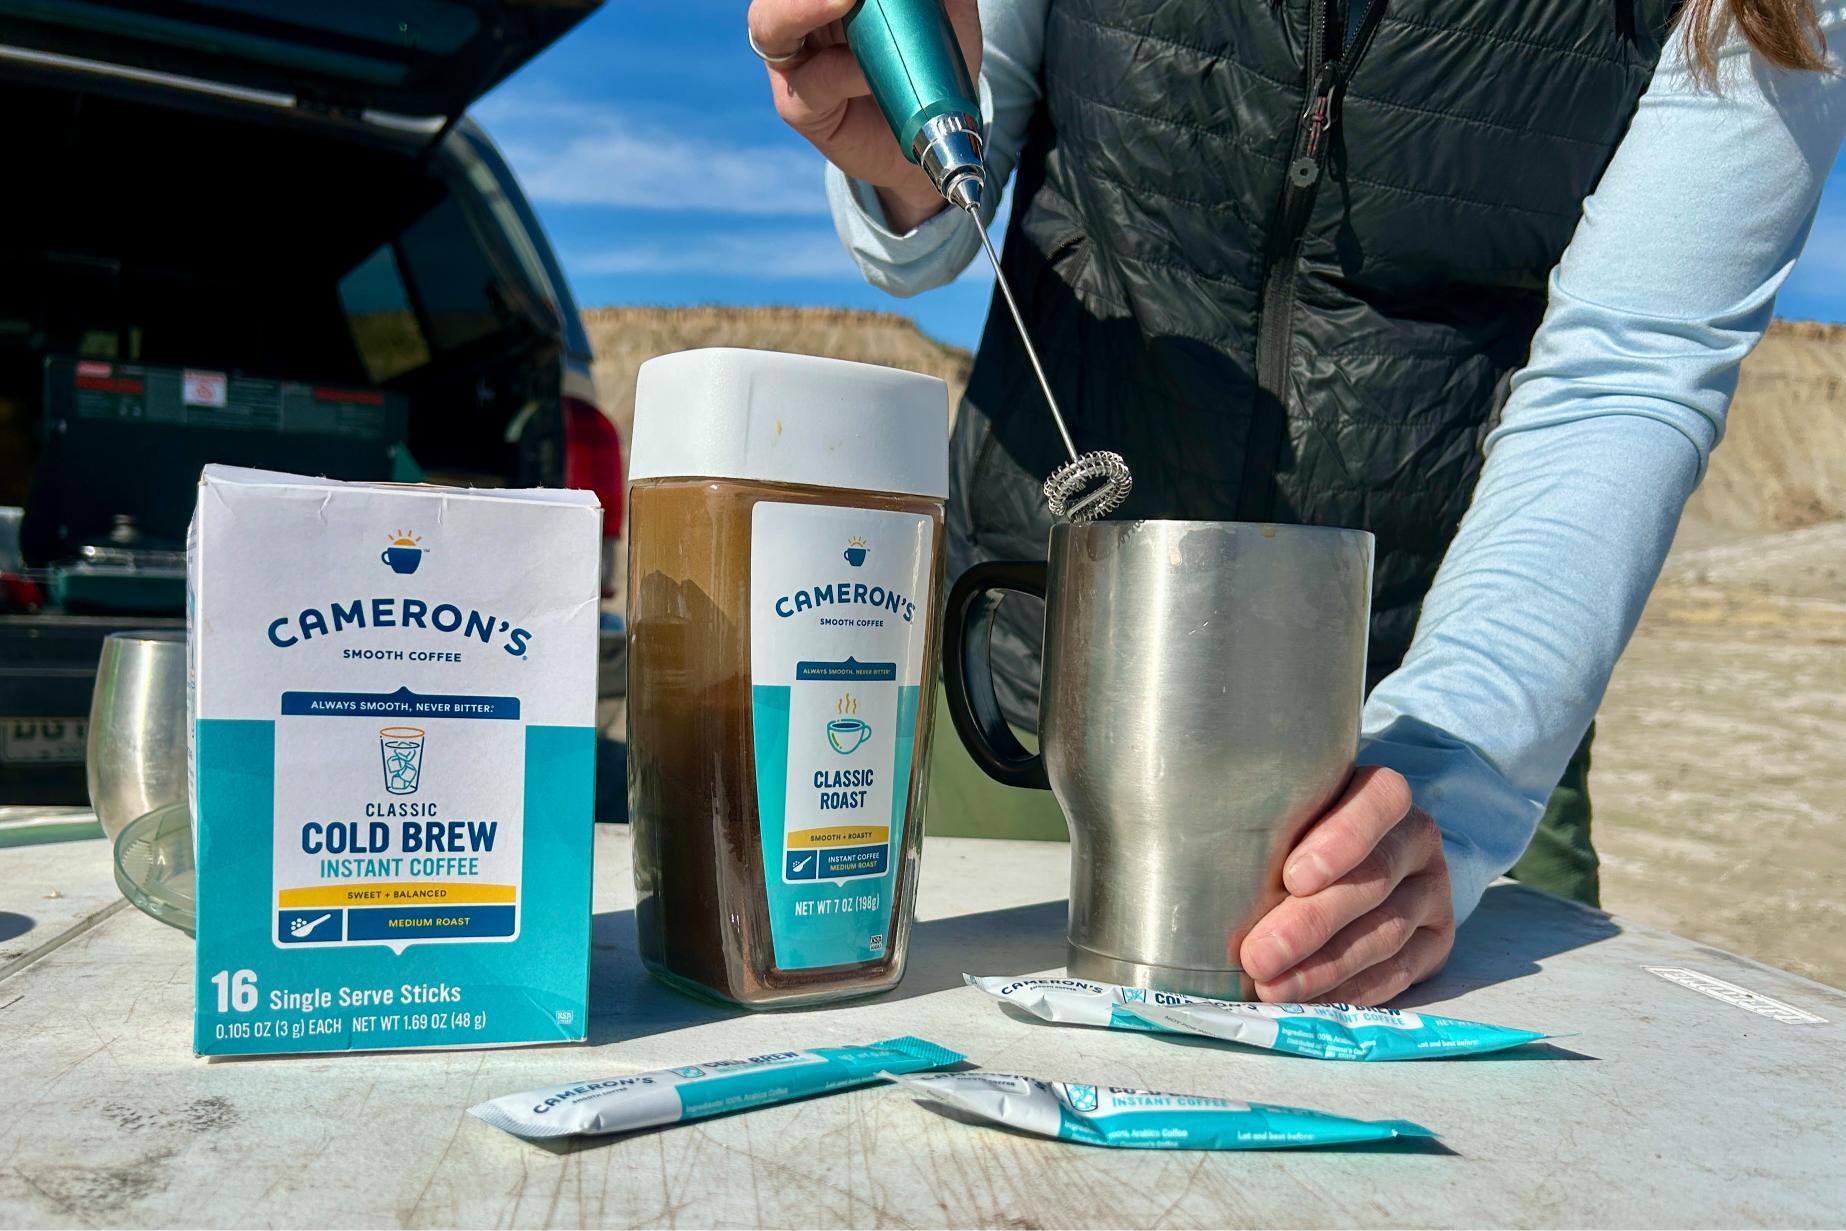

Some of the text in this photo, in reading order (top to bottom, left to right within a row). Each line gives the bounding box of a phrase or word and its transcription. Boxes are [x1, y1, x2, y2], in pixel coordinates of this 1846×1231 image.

[775, 583, 915, 623] CAMERON'S
[267, 598, 533, 657] CAMERON'S
[820, 618, 884, 627] SMOOTH COFFEE
[343, 649, 462, 662] SMOOTH COFFEE
[311, 701, 356, 711] ALWAYS
[360, 702, 412, 712] SMOOTH,
[416, 702, 451, 712] NEVER
[813, 769, 874, 788] CLASSIC
[820, 790, 867, 810] ROAST
[365, 803, 438, 817] CLASSIC
[302, 821, 498, 855] COLD BREW
[810, 833, 841, 842] SMOOTH
[847, 831, 873, 840] ROASTY
[828, 852, 880, 863] INSTANT COFFEE
[320, 857, 479, 878] INSTANT COFFEE
[830, 860, 878, 872] MEDIUM ROAST
[347, 890, 382, 900] SWEET
[393, 889, 447, 899] BALANCED
[795, 894, 880, 917] NET WT 7 OZ (198g)
[388, 917, 471, 928] MEDIUM ROAST
[211, 969, 462, 1013] 16 Single Serve Sticks
[1001, 979, 1104, 995] CAMERON'S
[215, 1012, 487, 1039] 0.105 OZ (3 g) EACH NET WT 1.69 OZ (48 g)
[1363, 1012, 1407, 1026] COFFEE
[533, 1077, 655, 1114] CAMERON'S
[1112, 1096, 1229, 1107] INSTANT COFFEE
[1161, 1127, 1189, 1138] Coffee
[1237, 1130, 1251, 1141] Lot
[1252, 1131, 1267, 1141] and
